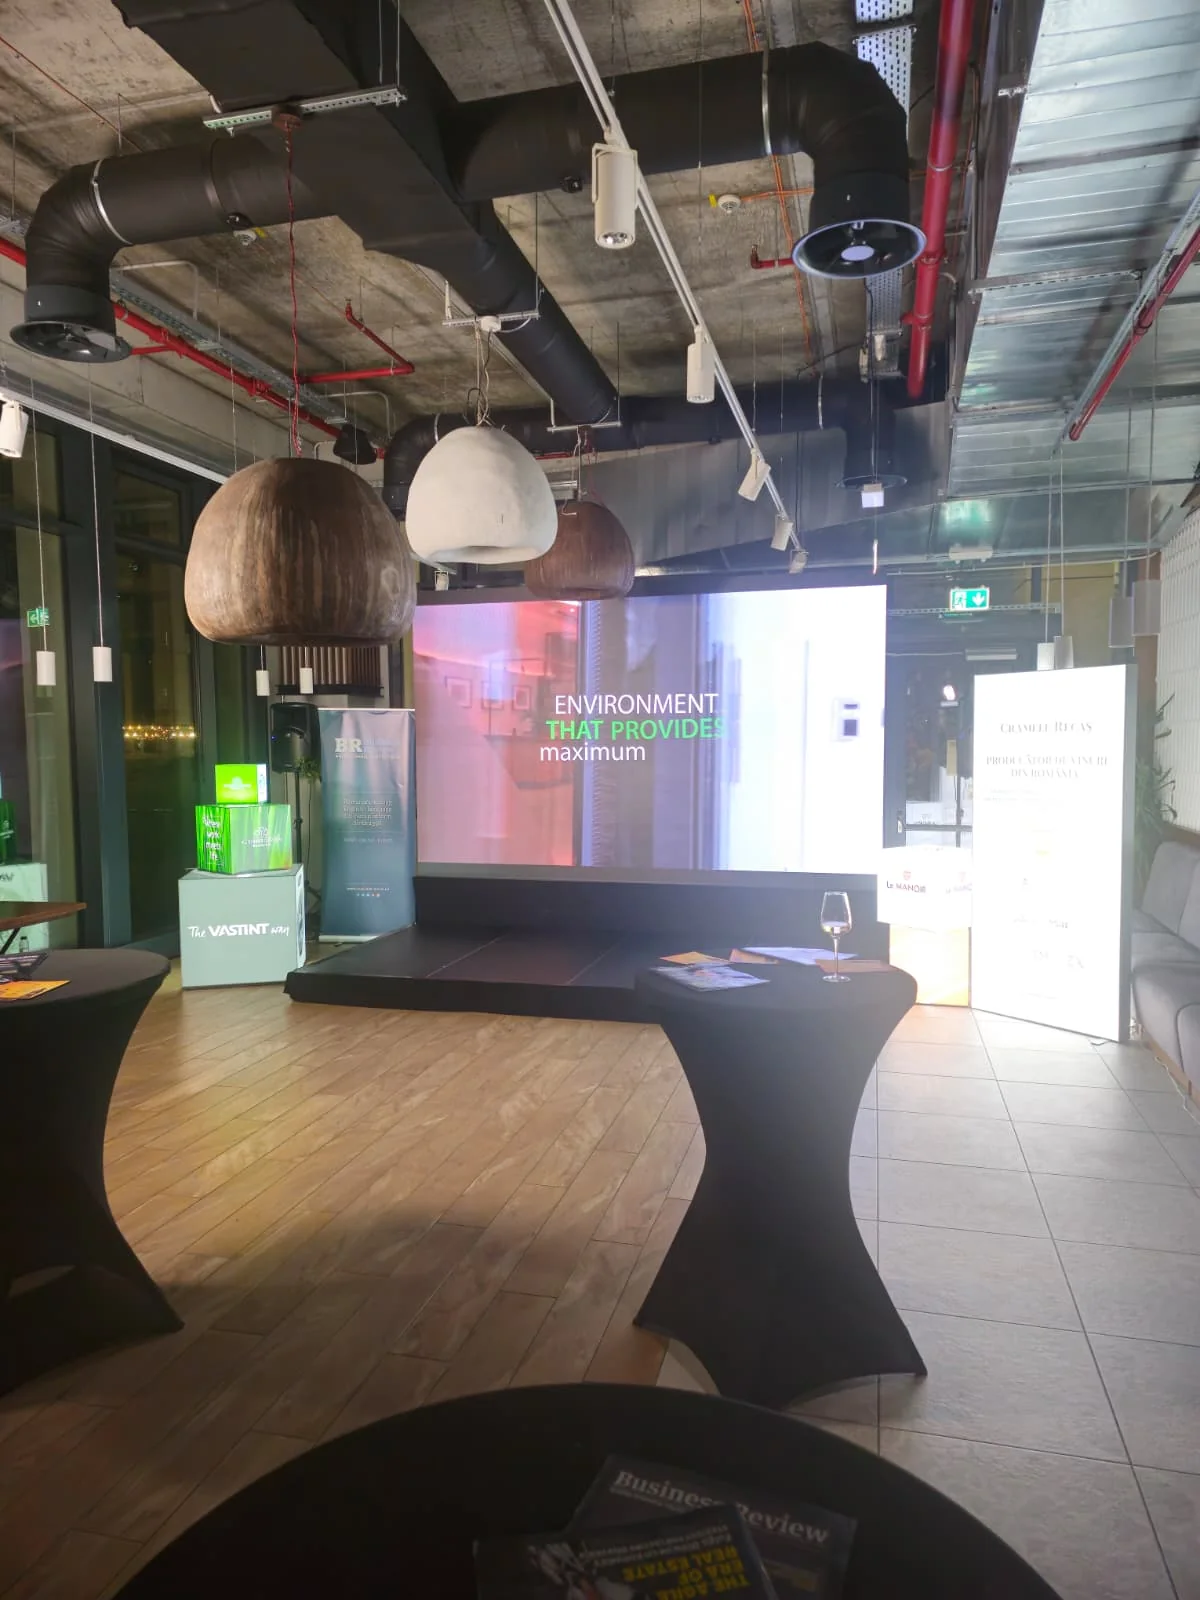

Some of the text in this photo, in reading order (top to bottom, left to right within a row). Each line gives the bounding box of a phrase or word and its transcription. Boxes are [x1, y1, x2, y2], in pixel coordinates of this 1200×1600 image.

[555, 693, 719, 715] ENVIRONMENT
[545, 717, 726, 740] THAT PROVIDES
[335, 738, 363, 754] BR
[540, 742, 646, 761] maximum
[188, 926, 206, 938] The
[207, 922, 270, 937] VASTINT
[614, 1470, 724, 1506] Busines
